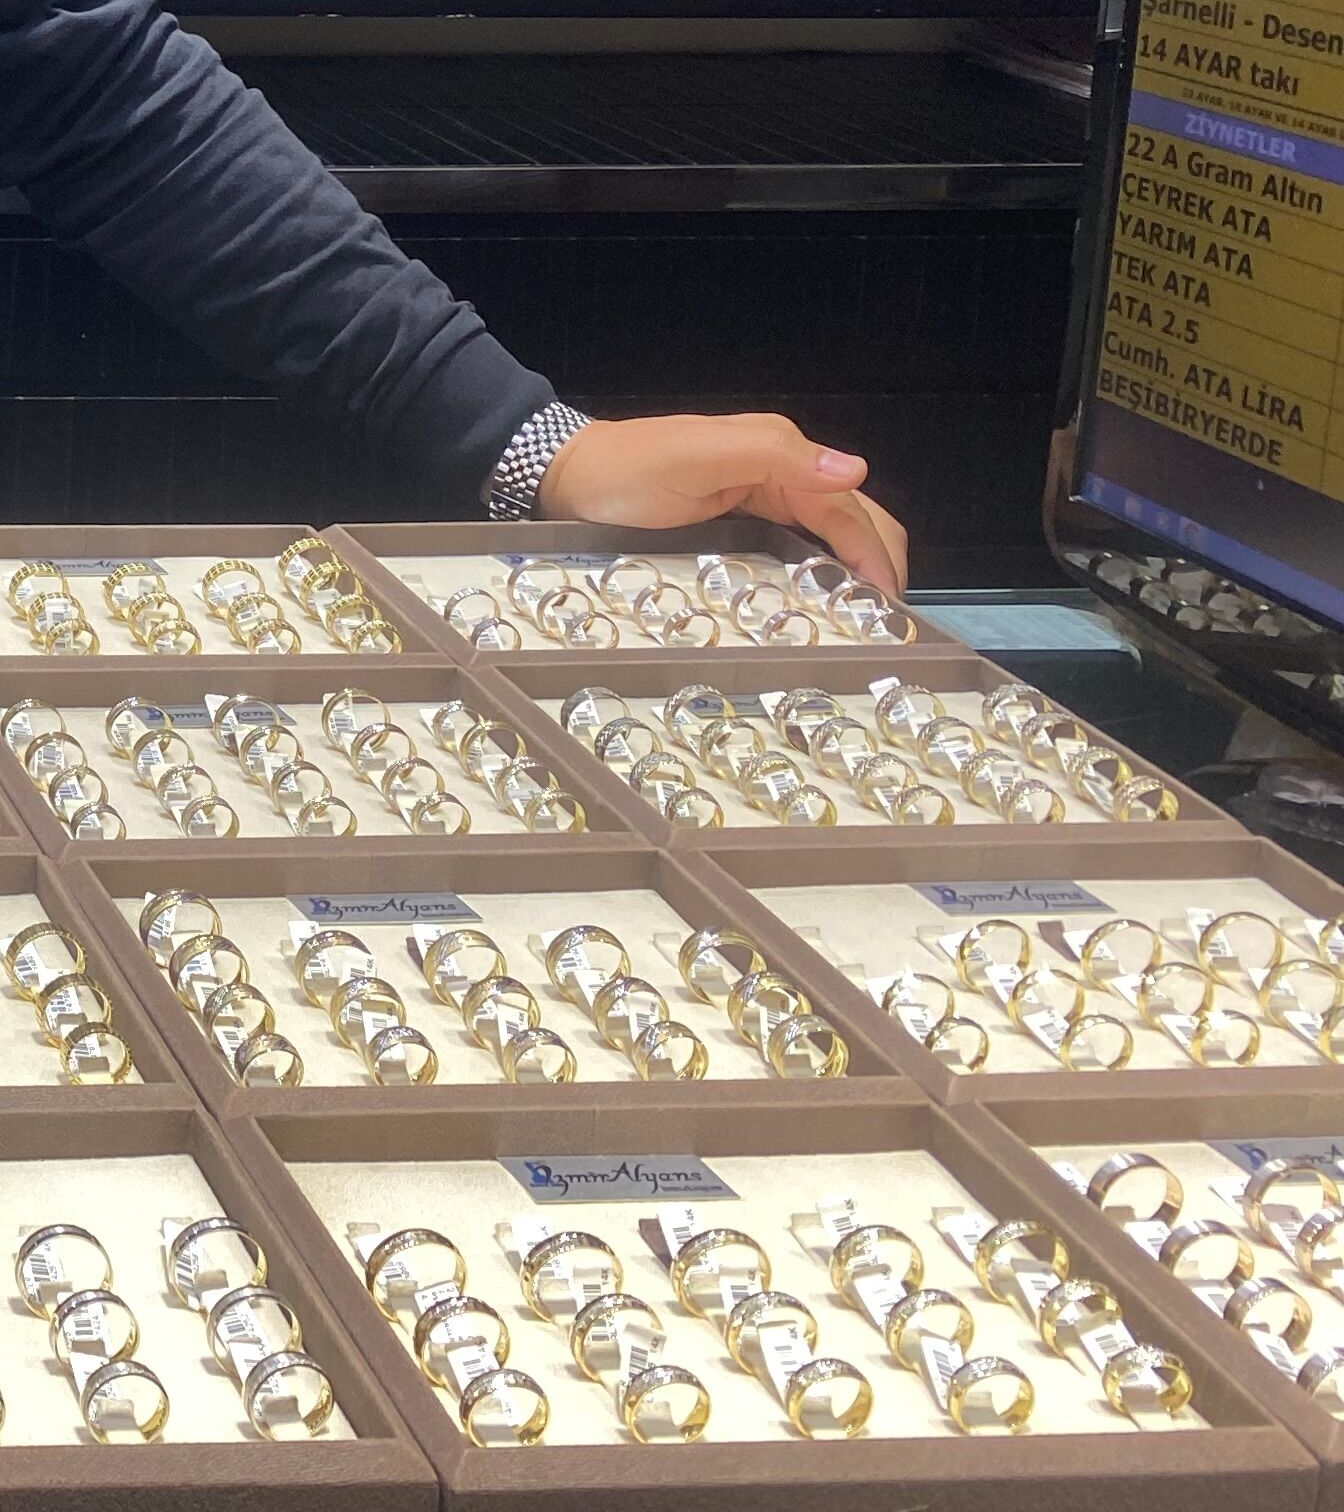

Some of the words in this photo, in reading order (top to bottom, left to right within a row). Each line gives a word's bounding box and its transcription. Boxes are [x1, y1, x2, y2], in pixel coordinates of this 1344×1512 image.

[1140, 34, 1167, 62] 14
[1174, 44, 1242, 81] AYAR
[1249, 62, 1300, 96] takı
[1184, 113, 1297, 163] ZİYNETLER
[1127, 133, 1155, 162] 22
[1162, 144, 1178, 169] A
[1187, 152, 1253, 192] Gram
[1262, 174, 1323, 214] Altın
[1122, 173, 1214, 223] ÇEYREK
[1222, 205, 1271, 242] ATA
[1118, 211, 1196, 260] YARIM
[1204, 242, 1253, 280] ATA
[1113, 250, 1157, 287] TEK
[1163, 270, 1211, 308] ATA
[1107, 291, 1152, 328] ATA
[1161, 310, 1200, 344] 2.5
[1104, 331, 1175, 379] Cumh.
[1184, 364, 1232, 403] ATA
[1241, 384, 1304, 432] LİRA
